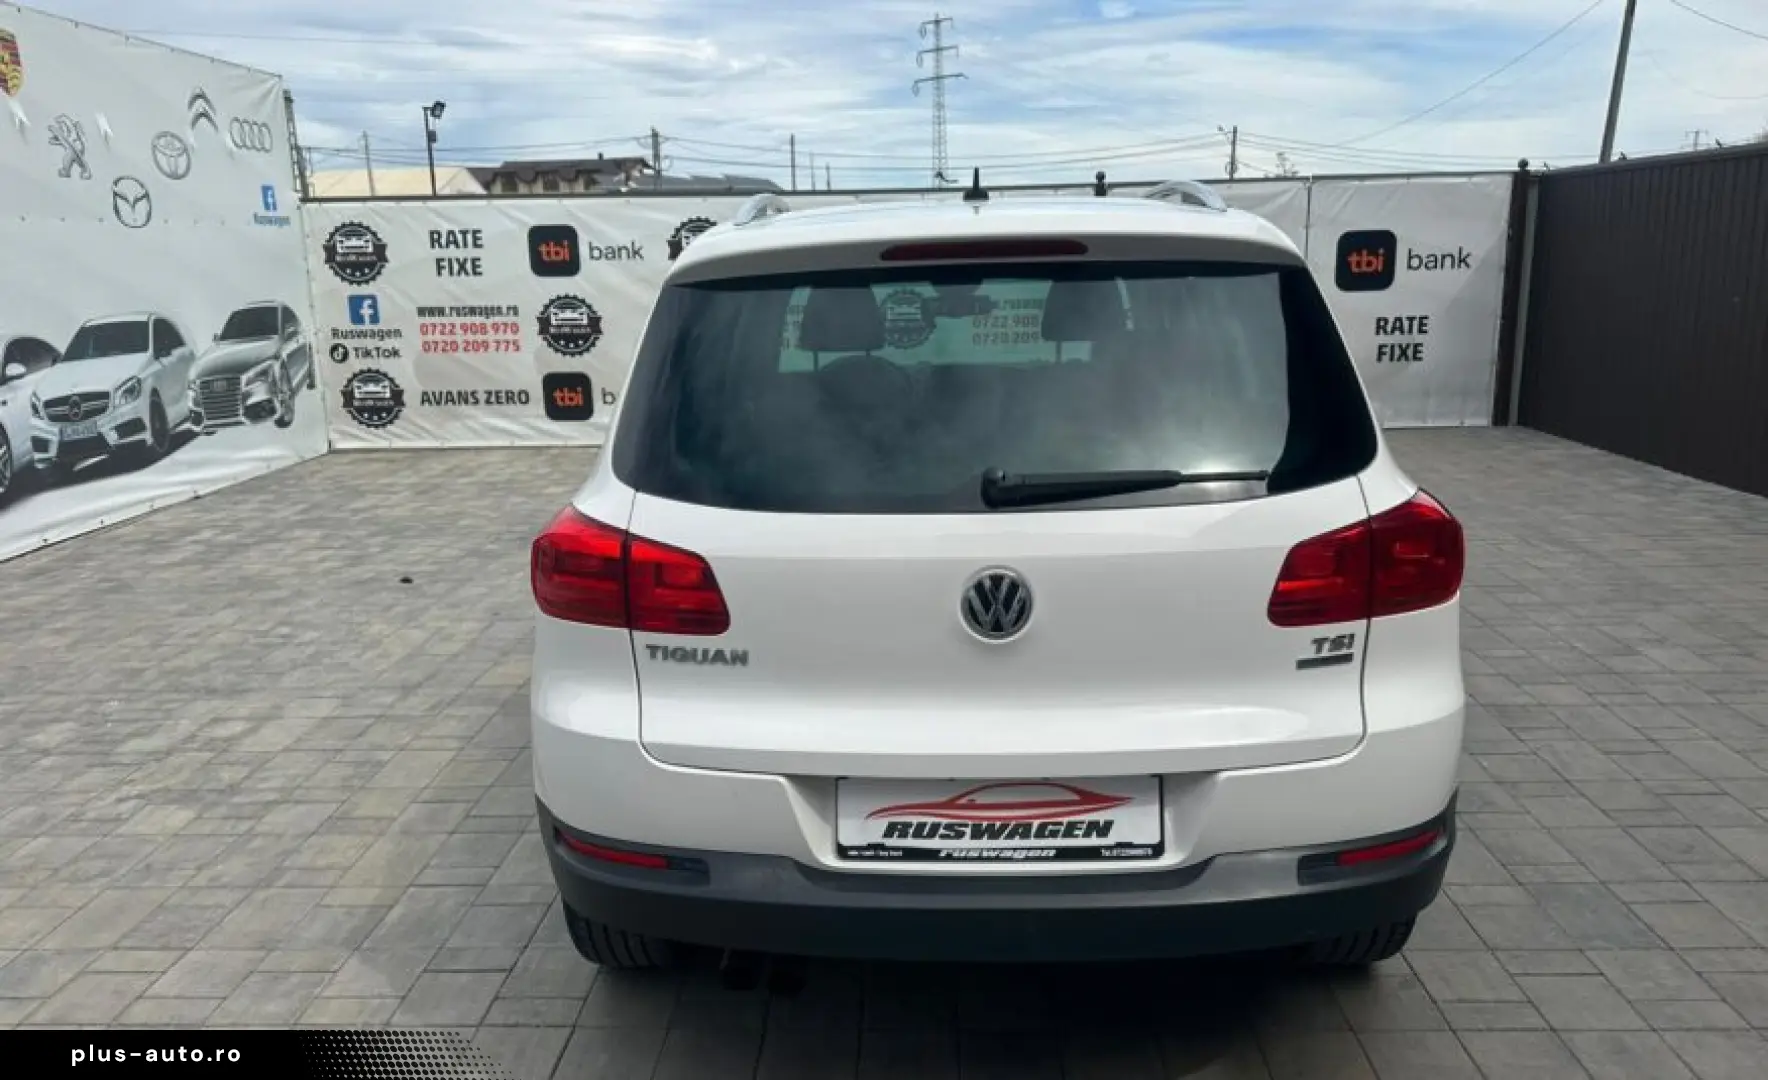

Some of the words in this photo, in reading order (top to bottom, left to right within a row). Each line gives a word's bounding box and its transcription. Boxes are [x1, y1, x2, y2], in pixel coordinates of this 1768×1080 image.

[429, 229, 483, 249] RATE
[538, 240, 570, 261] tbi
[588, 240, 644, 261] bank
[1347, 249, 1384, 273] tbi
[1406, 246, 1472, 271] bank
[435, 257, 483, 277] FIXE
[331, 328, 403, 341] Ruswagen
[420, 322, 456, 336] 0722
[460, 322, 487, 336] 908
[491, 322, 519, 335] 970
[1374, 316, 1430, 336] RATE
[353, 345, 402, 359] TikTok
[422, 340, 458, 353] 0720
[463, 340, 488, 353] 209
[492, 340, 520, 352] 775
[1376, 343, 1424, 363] FIXE
[419, 389, 480, 406] AVANS
[483, 389, 530, 405] ZERO
[552, 387, 584, 407] tbi
[646, 643, 750, 668] TIGUAN
[882, 819, 1114, 840] RUSWAGEN
